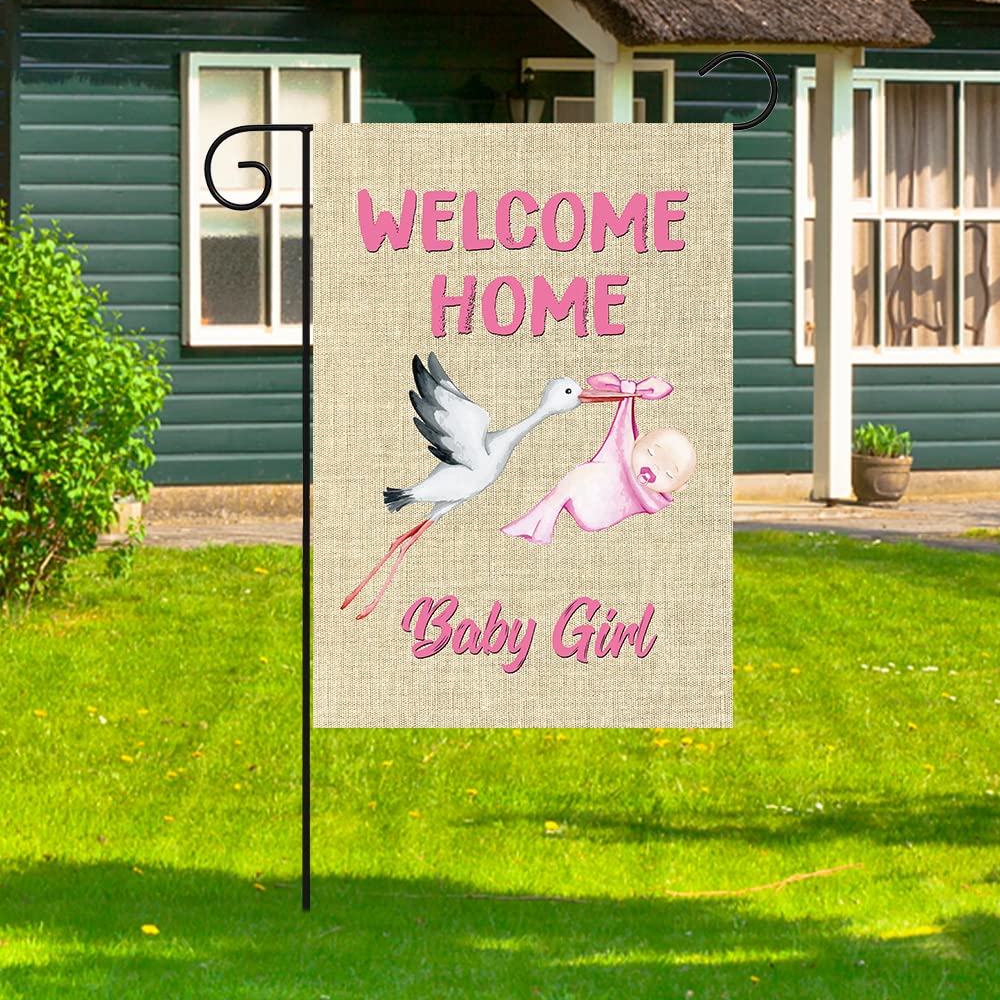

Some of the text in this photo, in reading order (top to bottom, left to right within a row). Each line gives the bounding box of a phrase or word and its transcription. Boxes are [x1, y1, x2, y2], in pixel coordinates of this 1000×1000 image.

[357, 188, 690, 254] WELCOME
[430, 273, 630, 338] HOME
[401, 595, 658, 674] Baby Girl
